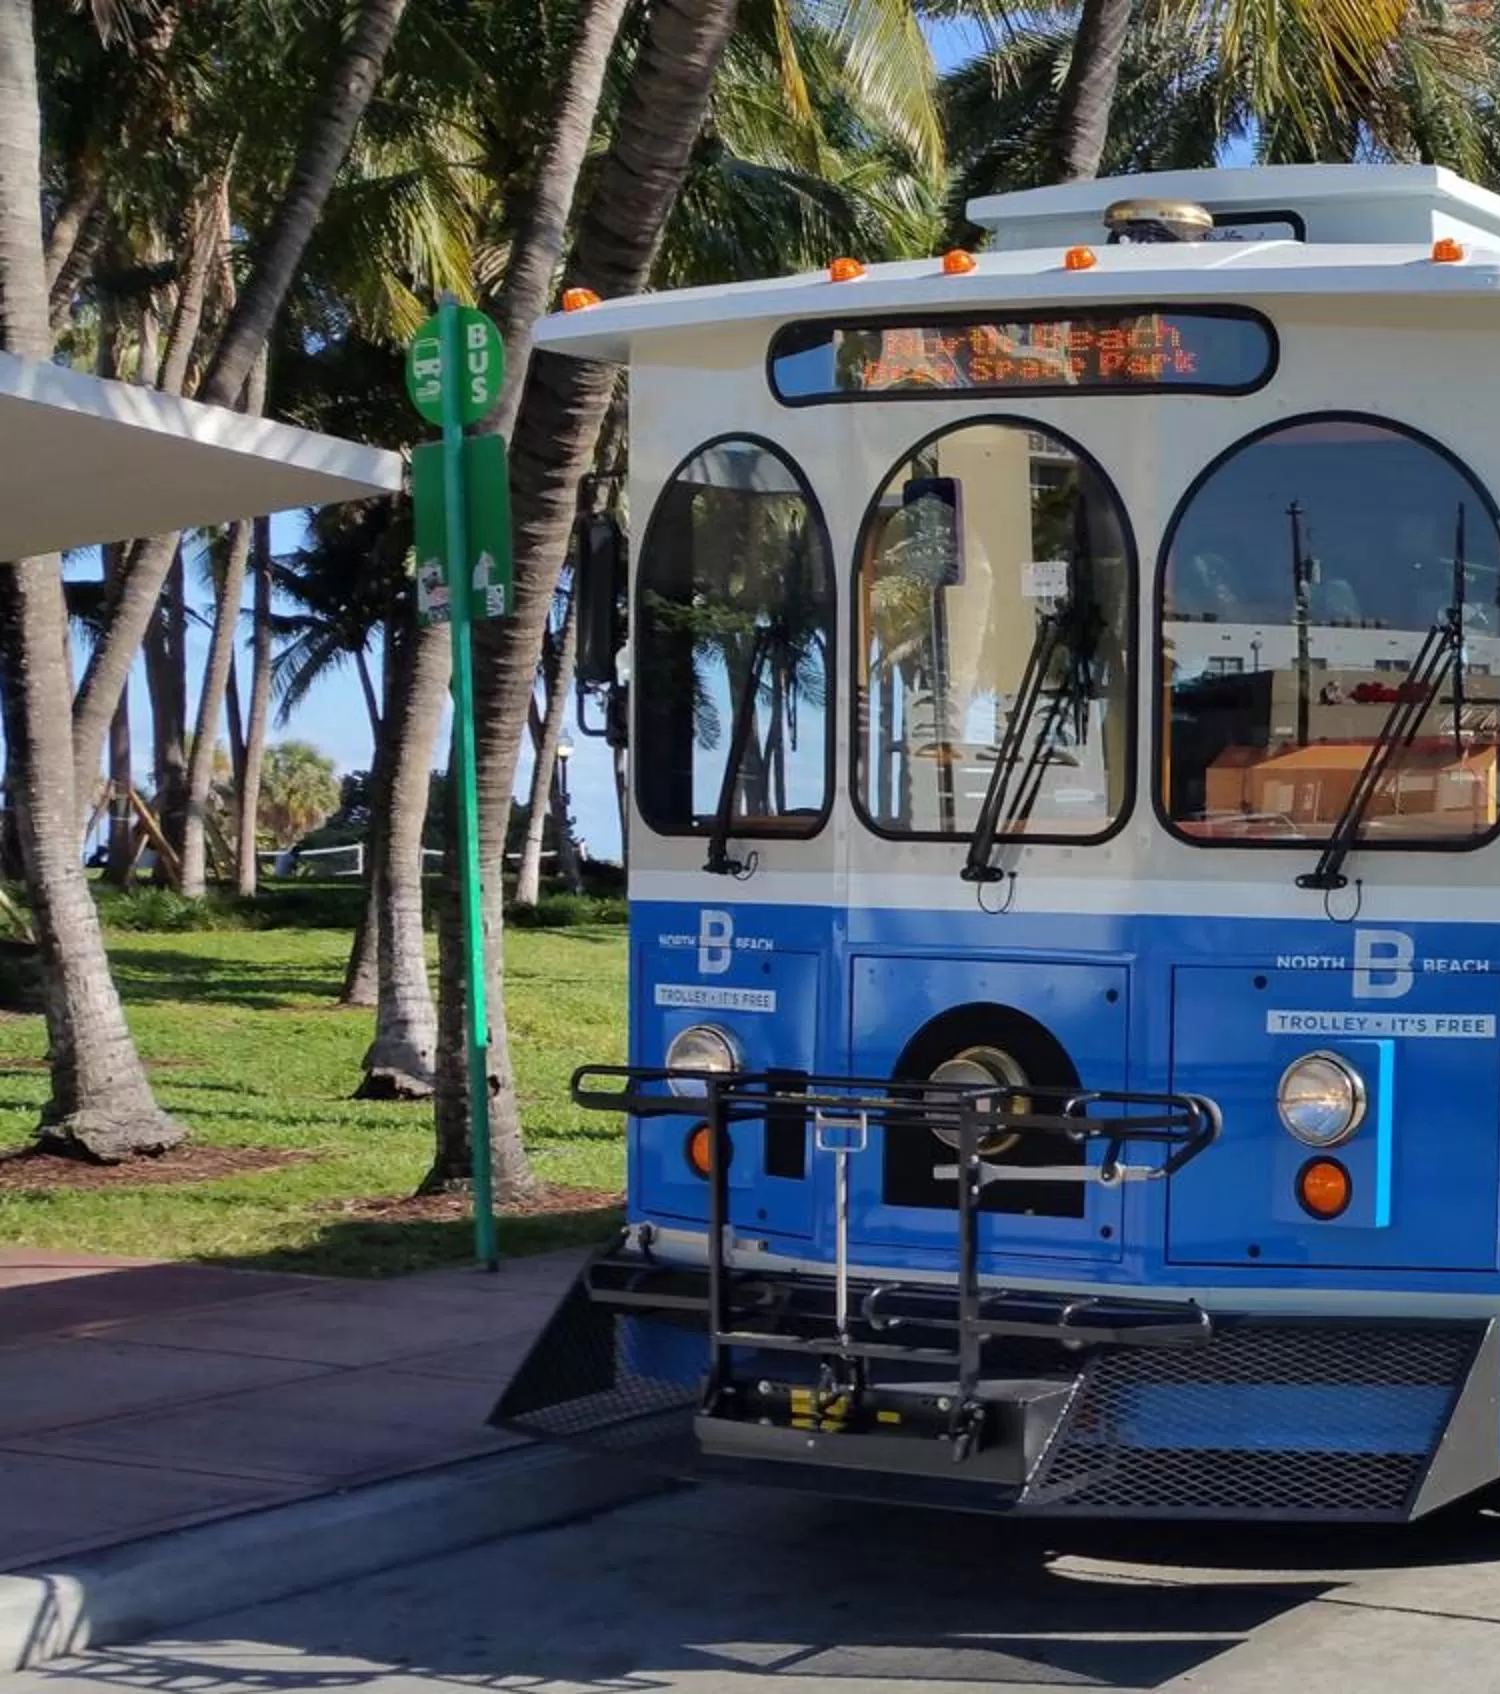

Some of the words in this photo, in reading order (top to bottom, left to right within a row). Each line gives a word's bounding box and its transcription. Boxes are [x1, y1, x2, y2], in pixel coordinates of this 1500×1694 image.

[466, 323, 489, 405] BUS
[698, 909, 734, 974] B
[1276, 955, 1345, 969] NORTH
[1352, 928, 1415, 999] B
[1423, 959, 1489, 972] BEACH
[1278, 1014, 1368, 1031] TROLLEY
[1391, 1017, 1427, 1033] IT'S
[1436, 1018, 1486, 1034] FREE
